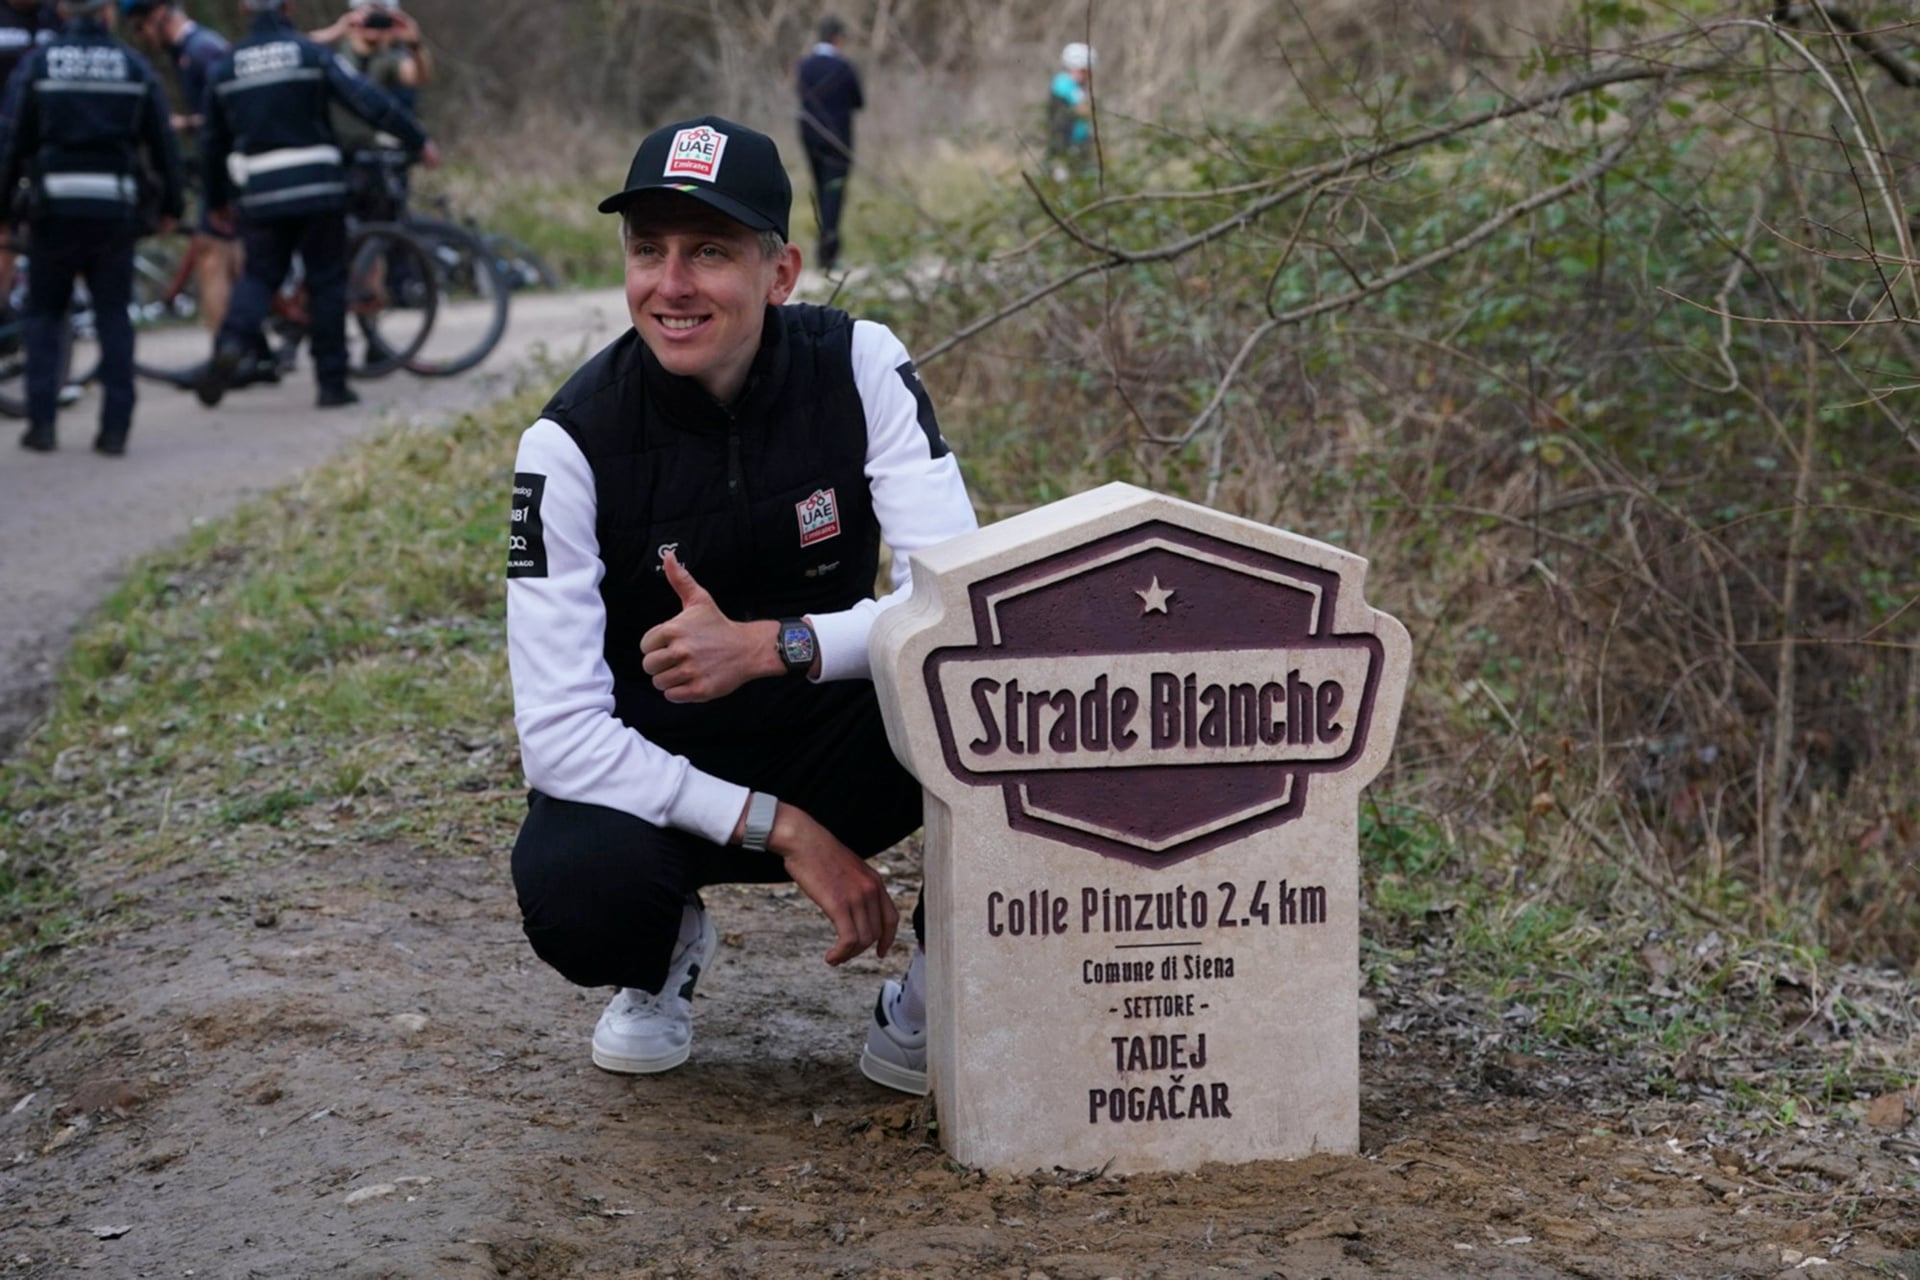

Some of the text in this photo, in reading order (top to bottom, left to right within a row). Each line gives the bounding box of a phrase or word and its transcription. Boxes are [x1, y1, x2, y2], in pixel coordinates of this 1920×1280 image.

[679, 141, 714, 156] UAE
[803, 503, 832, 525] UAE
[969, 668, 1345, 756] Strade Bianche
[987, 879, 1327, 937] Colle Pinzuto 2.4 km
[1083, 954, 1235, 985] Comune di Siena
[1123, 994, 1195, 1019] SETTORE
[1111, 1033, 1207, 1072] TADEJ
[1088, 1074, 1232, 1124] POGAČAR
